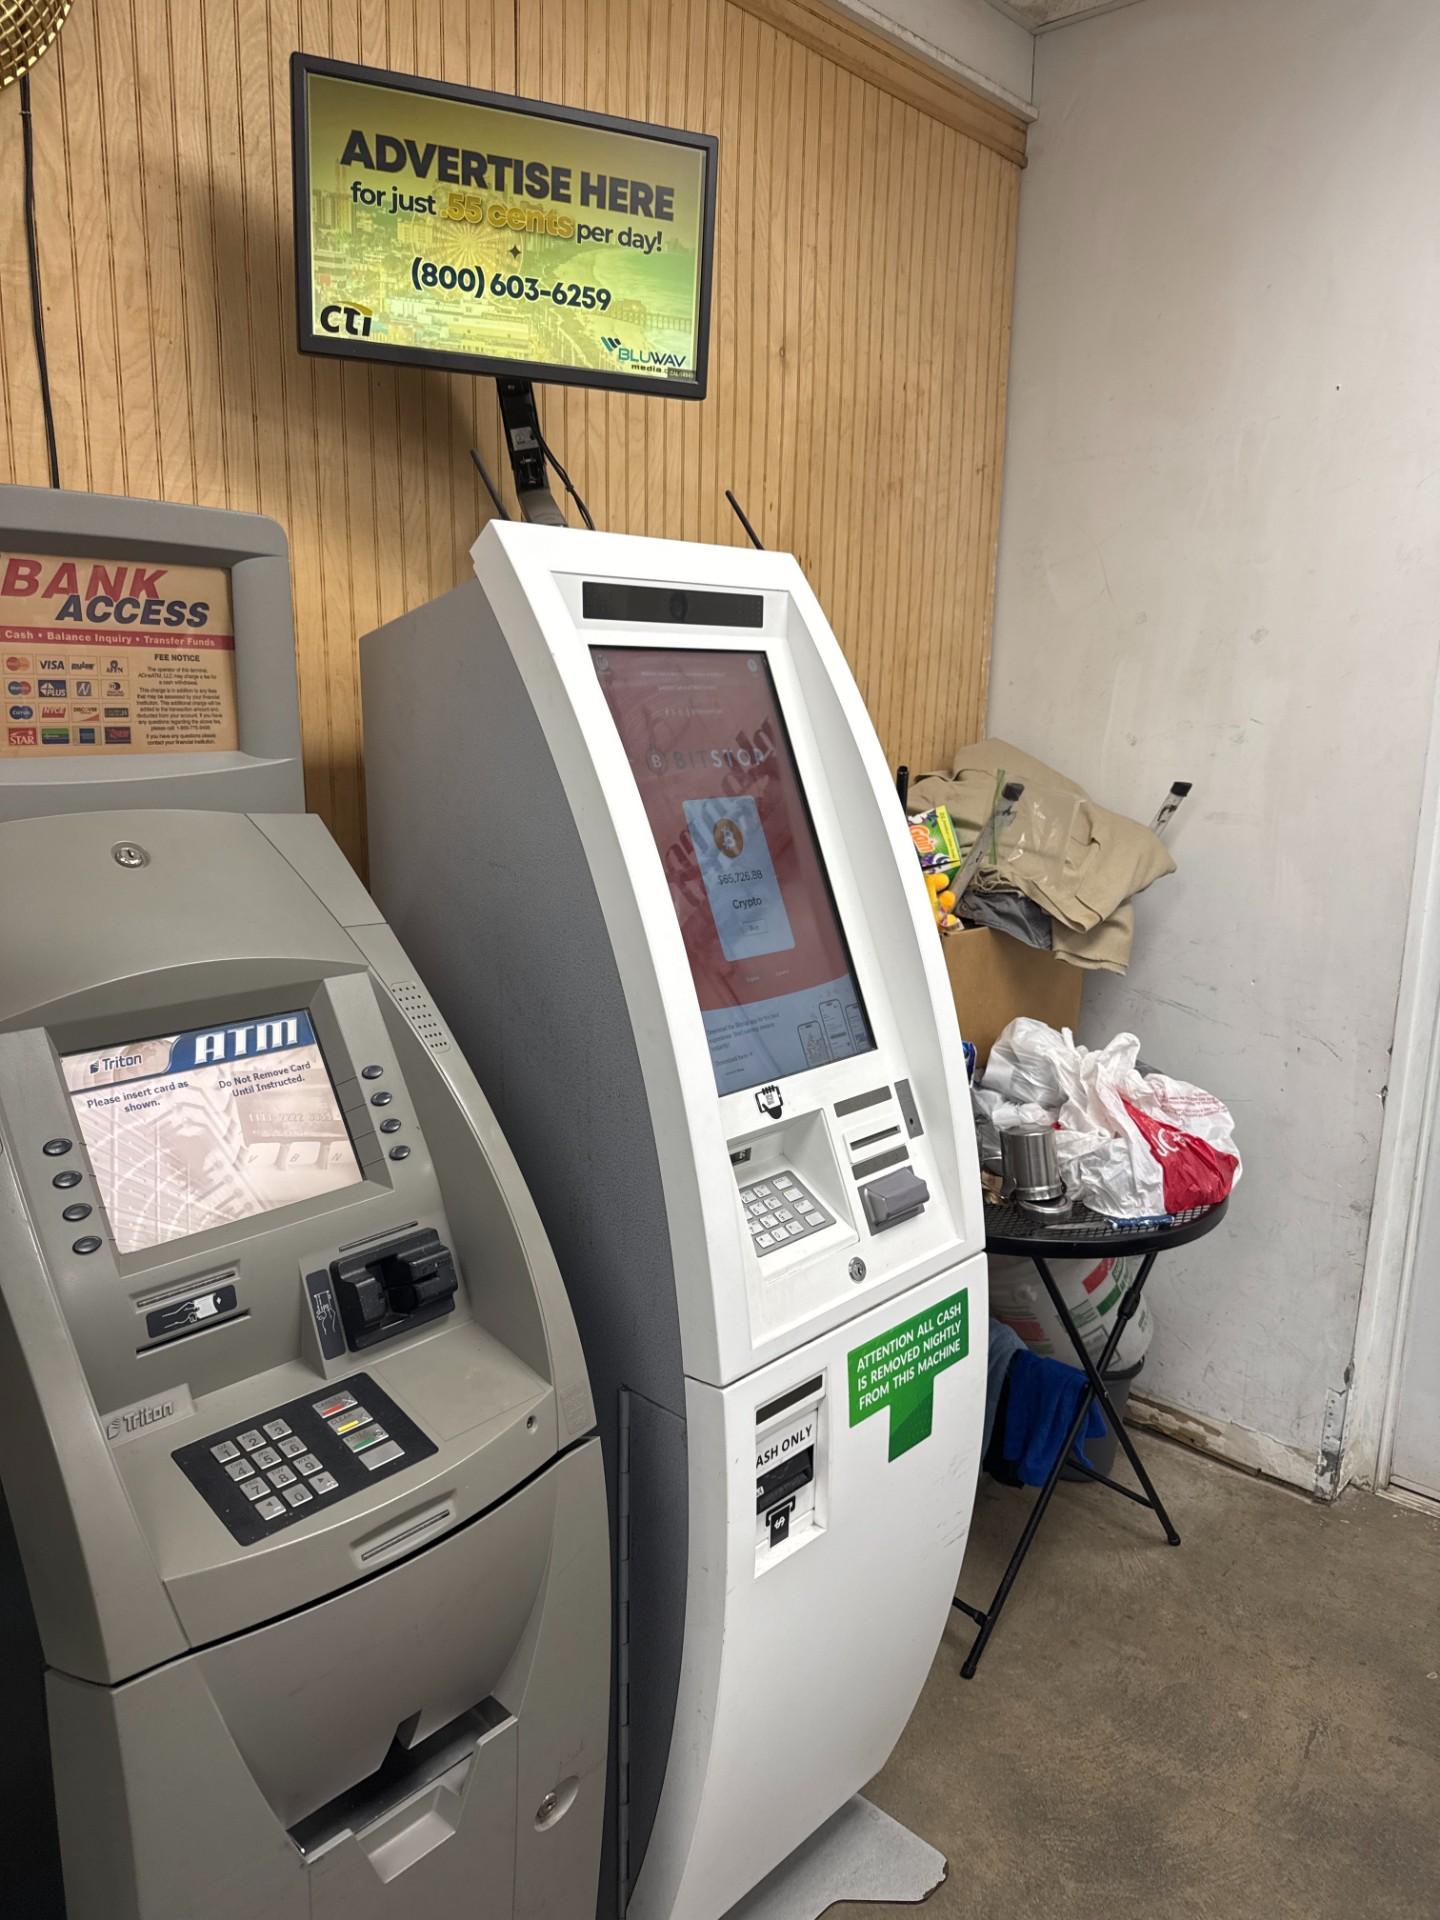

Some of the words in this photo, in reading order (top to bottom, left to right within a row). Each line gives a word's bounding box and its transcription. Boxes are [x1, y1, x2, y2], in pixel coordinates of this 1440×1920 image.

[340, 129, 572, 204] ADVERTISE
[579, 171, 675, 221] HERE
[351, 180, 387, 207] for
[388, 186, 437, 215] just
[487, 203, 574, 239] cents
[577, 223, 613, 245] per
[617, 230, 663, 254] day!
[411, 257, 485, 298] (800)
[490, 272, 613, 311] 603-6259
[618, 347, 686, 367] BLUWAV
[631, 364, 662, 373] media
[1, 558, 168, 601] BANK
[55, 594, 210, 628] ACCESS
[5, 630, 34, 640] Cash
[47, 631, 91, 642] Balance
[95, 634, 132, 645] Inquiry
[144, 635, 184, 646] Transfer
[187, 636, 215, 647] Funds
[40, 660, 65, 670] VISA
[171, 654, 200, 662] NOTICE
[10, 736, 35, 745] STAR
[732, 896, 762, 910] Crypto
[195, 1017, 298, 1064] ATM
[102, 1054, 142, 1071] Triton
[218, 1079, 232, 1089] Do
[234, 1074, 251, 1086] Not
[253, 1068, 289, 1083] Remove
[289, 1061, 311, 1075] Card
[87, 1094, 121, 1109] Please
[123, 1089, 151, 1103] insert
[154, 1083, 176, 1097] card
[178, 1081, 189, 1090] as
[232, 1086, 254, 1098] Until
[256, 1075, 305, 1093] Instructed.
[124, 1099, 160, 1113] shown.
[856, 1331, 914, 1373] ATTENTION
[916, 1318, 935, 1337] ALL
[936, 1302, 962, 1325] CASH
[858, 1376, 868, 1391] IS
[870, 1346, 920, 1385] REMOVED
[923, 1319, 962, 1351] NIGHTLY
[859, 1384, 890, 1411] FROM
[892, 1367, 915, 1390] THIS
[917, 1337, 961, 1379] MACHINE
[122, 1402, 174, 1433] Triton
[275, 1427, 284, 1435] 3
[249, 1438, 258, 1447] 2
[290, 1444, 300, 1453] 6
[756, 1444, 779, 1469] ASH
[781, 1423, 813, 1452] ONLY
[264, 1455, 273, 1464] 5
[305, 1462, 315, 1471] 9
[279, 1474, 289, 1483] 8
[251, 1485, 260, 1495] 7
[295, 1493, 304, 1501] 0
